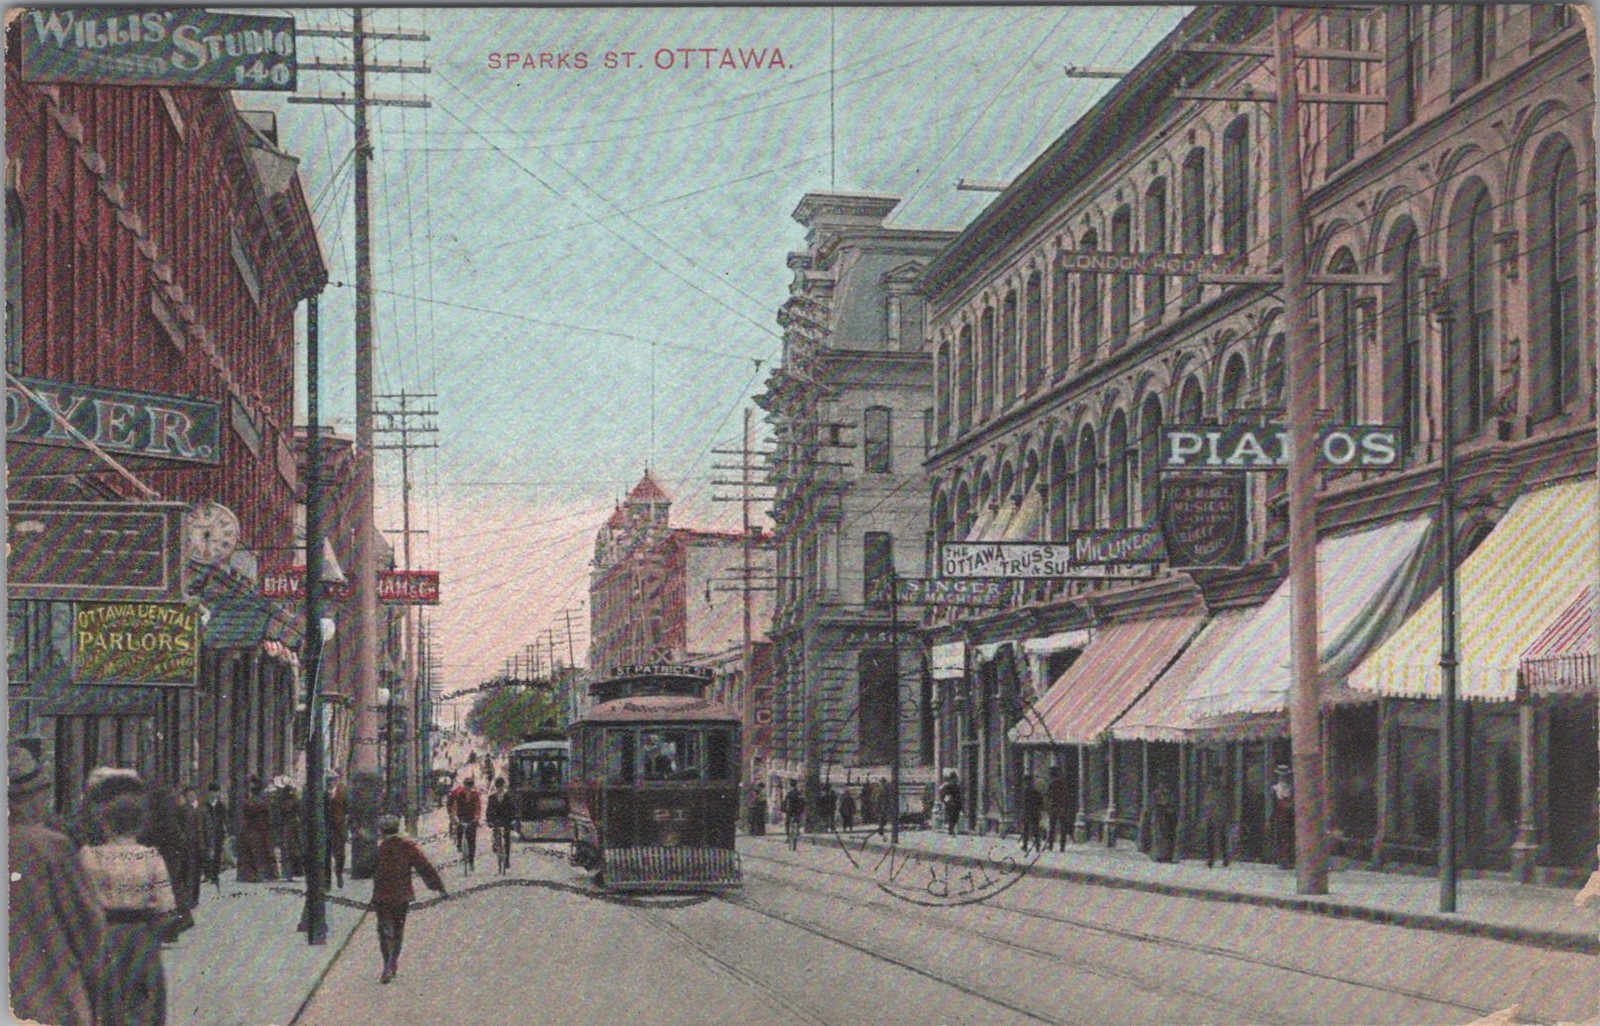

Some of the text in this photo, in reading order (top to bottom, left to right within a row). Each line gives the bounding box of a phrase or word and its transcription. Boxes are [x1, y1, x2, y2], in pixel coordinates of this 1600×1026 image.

[172, 26, 294, 71] STUDIO
[236, 59, 291, 84] 140
[945, 547, 969, 558] THE
[945, 545, 1055, 575] OTTAWA TRUSS
[906, 580, 1000, 595] SINGER
[79, 604, 135, 628] OTTAWA
[79, 630, 190, 652] PARLORS
[635, 665, 690, 674] PATRICK
